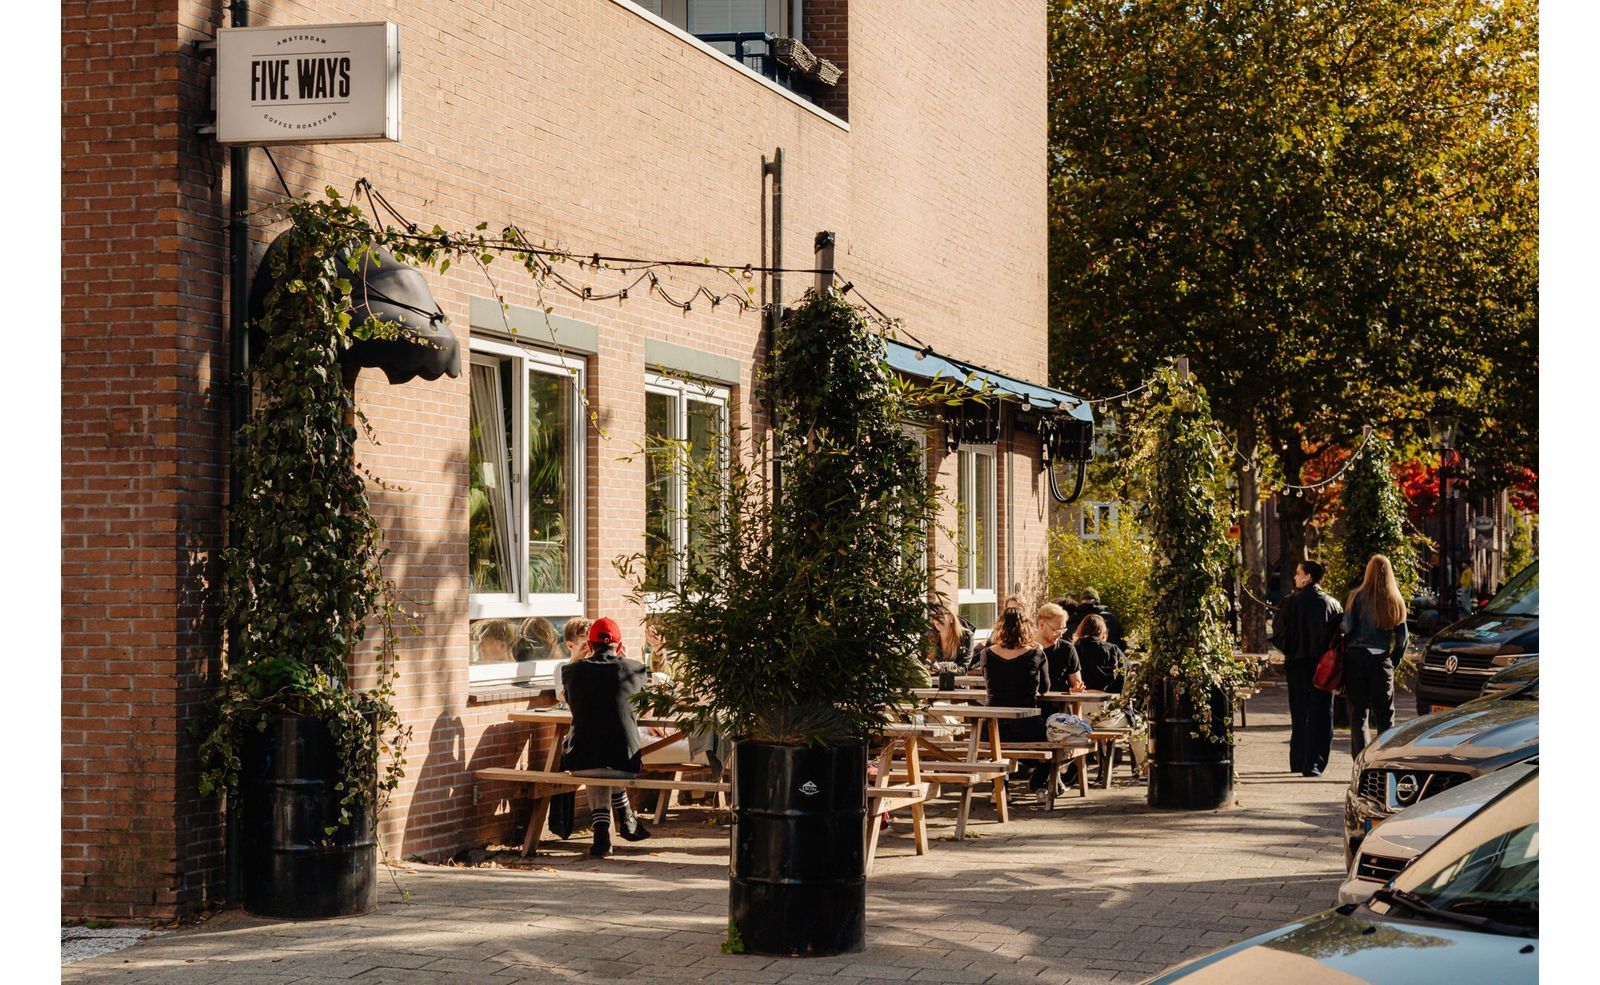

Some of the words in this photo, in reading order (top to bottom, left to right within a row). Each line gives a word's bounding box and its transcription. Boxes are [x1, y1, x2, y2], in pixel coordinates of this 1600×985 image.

[277, 35, 327, 46] AMSTERDAM
[251, 60, 290, 101] FIVE
[297, 57, 350, 99] WAYS
[264, 113, 292, 129] COFFEE
[296, 111, 337, 129] ROASTERS
